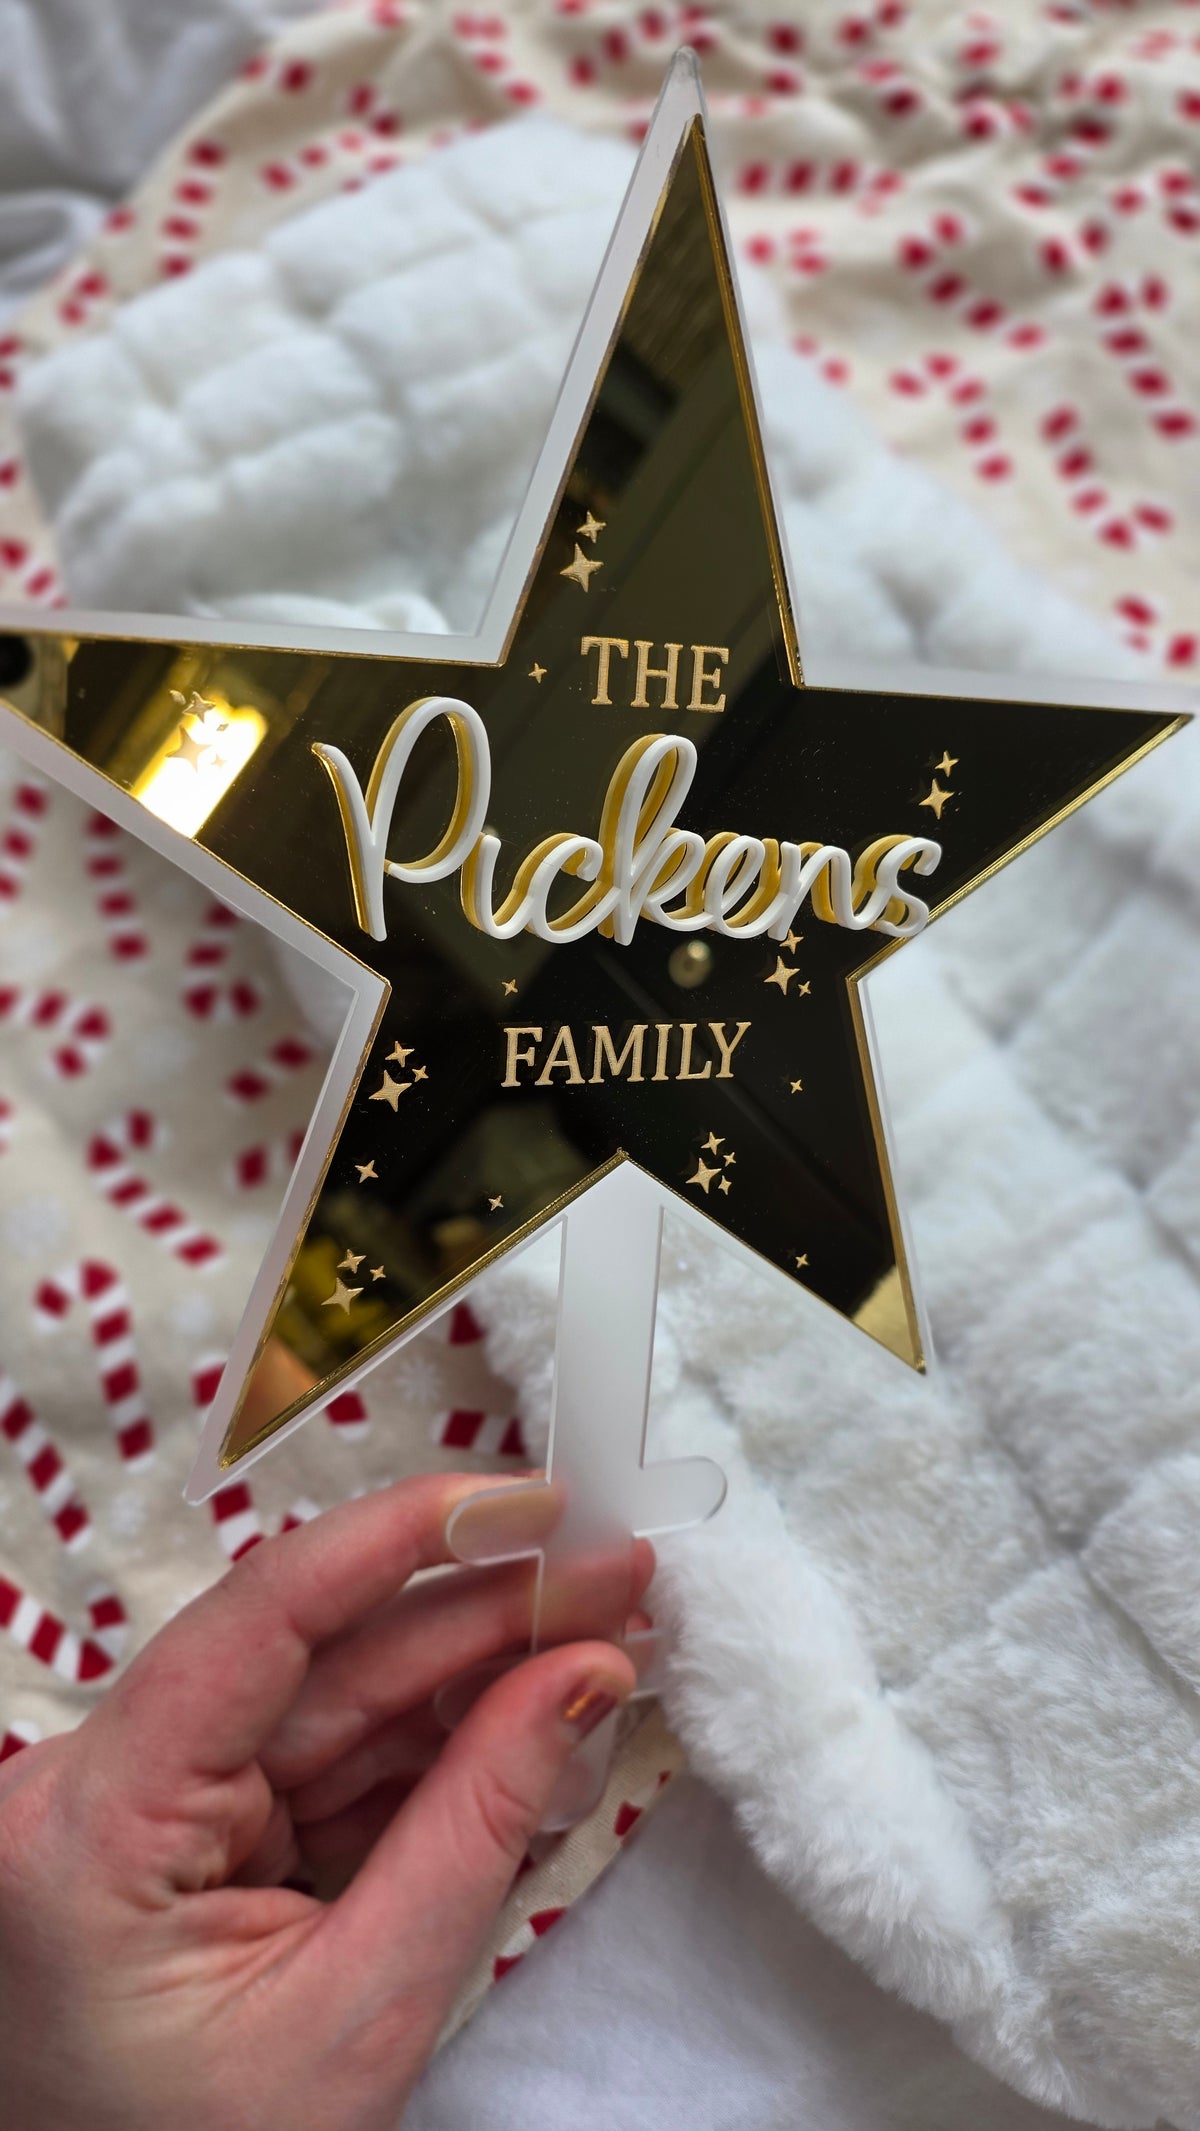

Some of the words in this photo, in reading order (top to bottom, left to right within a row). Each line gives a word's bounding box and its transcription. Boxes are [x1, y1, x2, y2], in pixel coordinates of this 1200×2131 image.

[581, 636, 730, 713] THE
[312, 696, 942, 946] Pickens
[501, 1021, 752, 1088] FAMILY
